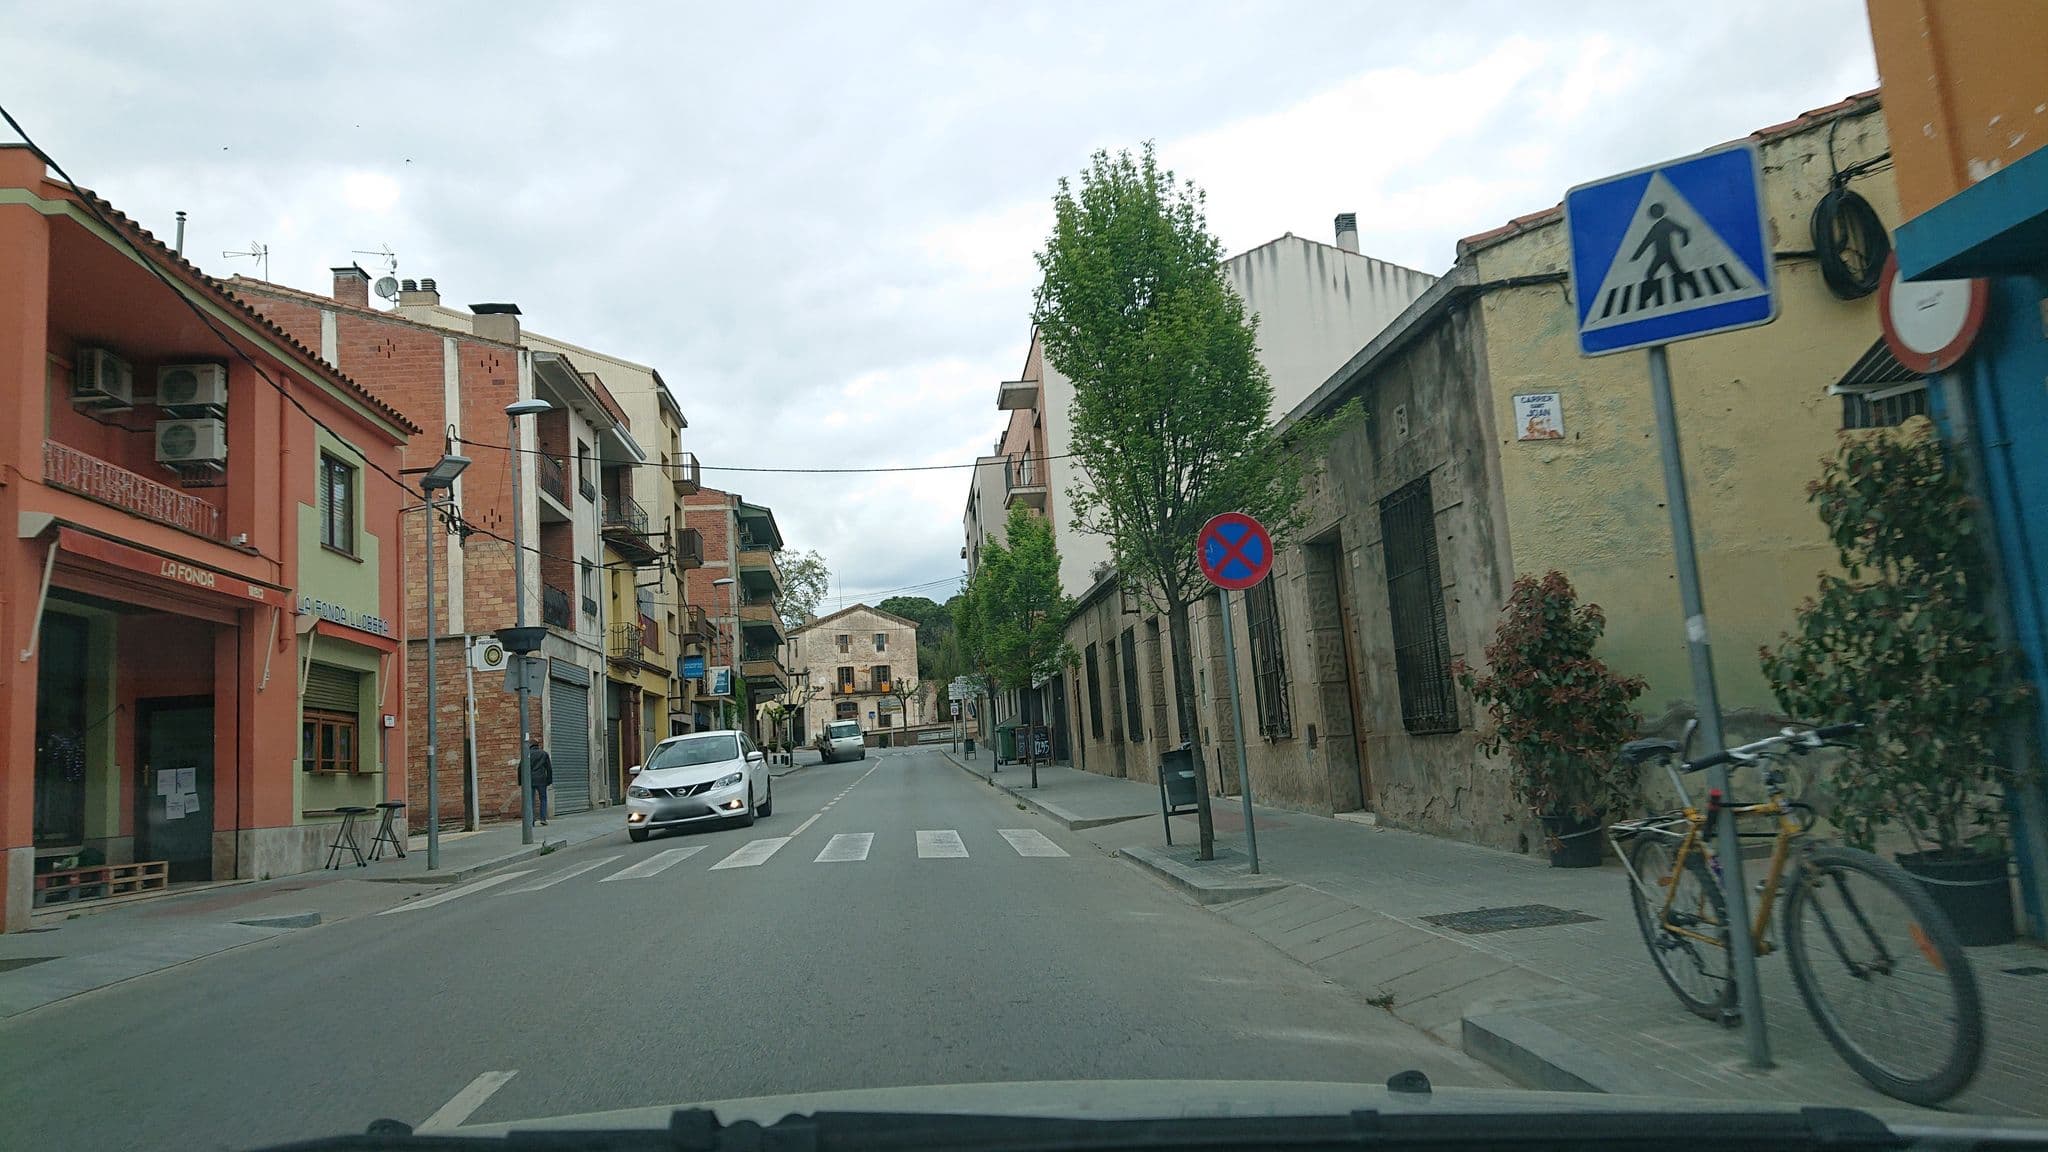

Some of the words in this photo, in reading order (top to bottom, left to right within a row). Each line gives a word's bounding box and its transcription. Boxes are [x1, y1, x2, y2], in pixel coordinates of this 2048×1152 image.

[1527, 409, 1550, 417] JOAN
[160, 561, 176, 577] LA
[177, 565, 215, 587] FONDA
[297, 594, 311, 614] LA
[315, 599, 347, 624] FONDA
[350, 611, 388, 635] LLOBERA
